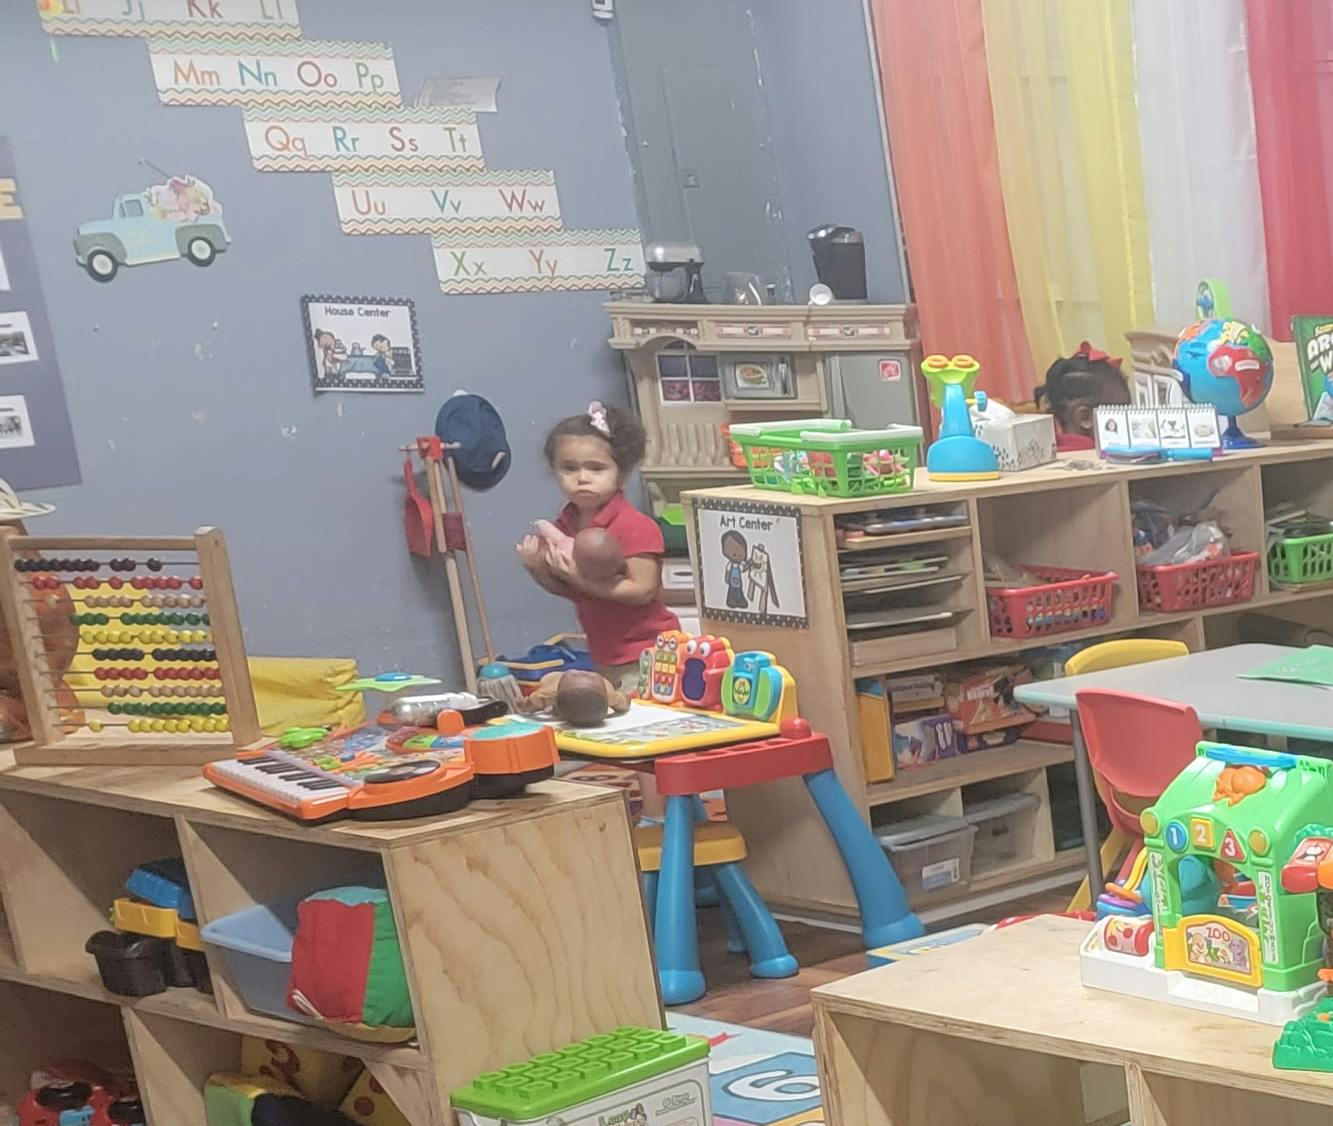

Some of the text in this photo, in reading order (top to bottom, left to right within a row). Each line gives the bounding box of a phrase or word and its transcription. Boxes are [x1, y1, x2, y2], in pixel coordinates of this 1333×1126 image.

[173, 59, 385, 95] Mm Nn Oo Pp
[264, 125, 468, 161] Qq Rr Ss Tt
[351, 188, 546, 216] Uu Vv Ww
[449, 248, 634, 284] Xx Yy Zz
[324, 306, 392, 318] House Center
[719, 514, 774, 532] Art Center
[1170, 824, 1237, 857] 1 2 3
[1206, 925, 1232, 943] ZOO
